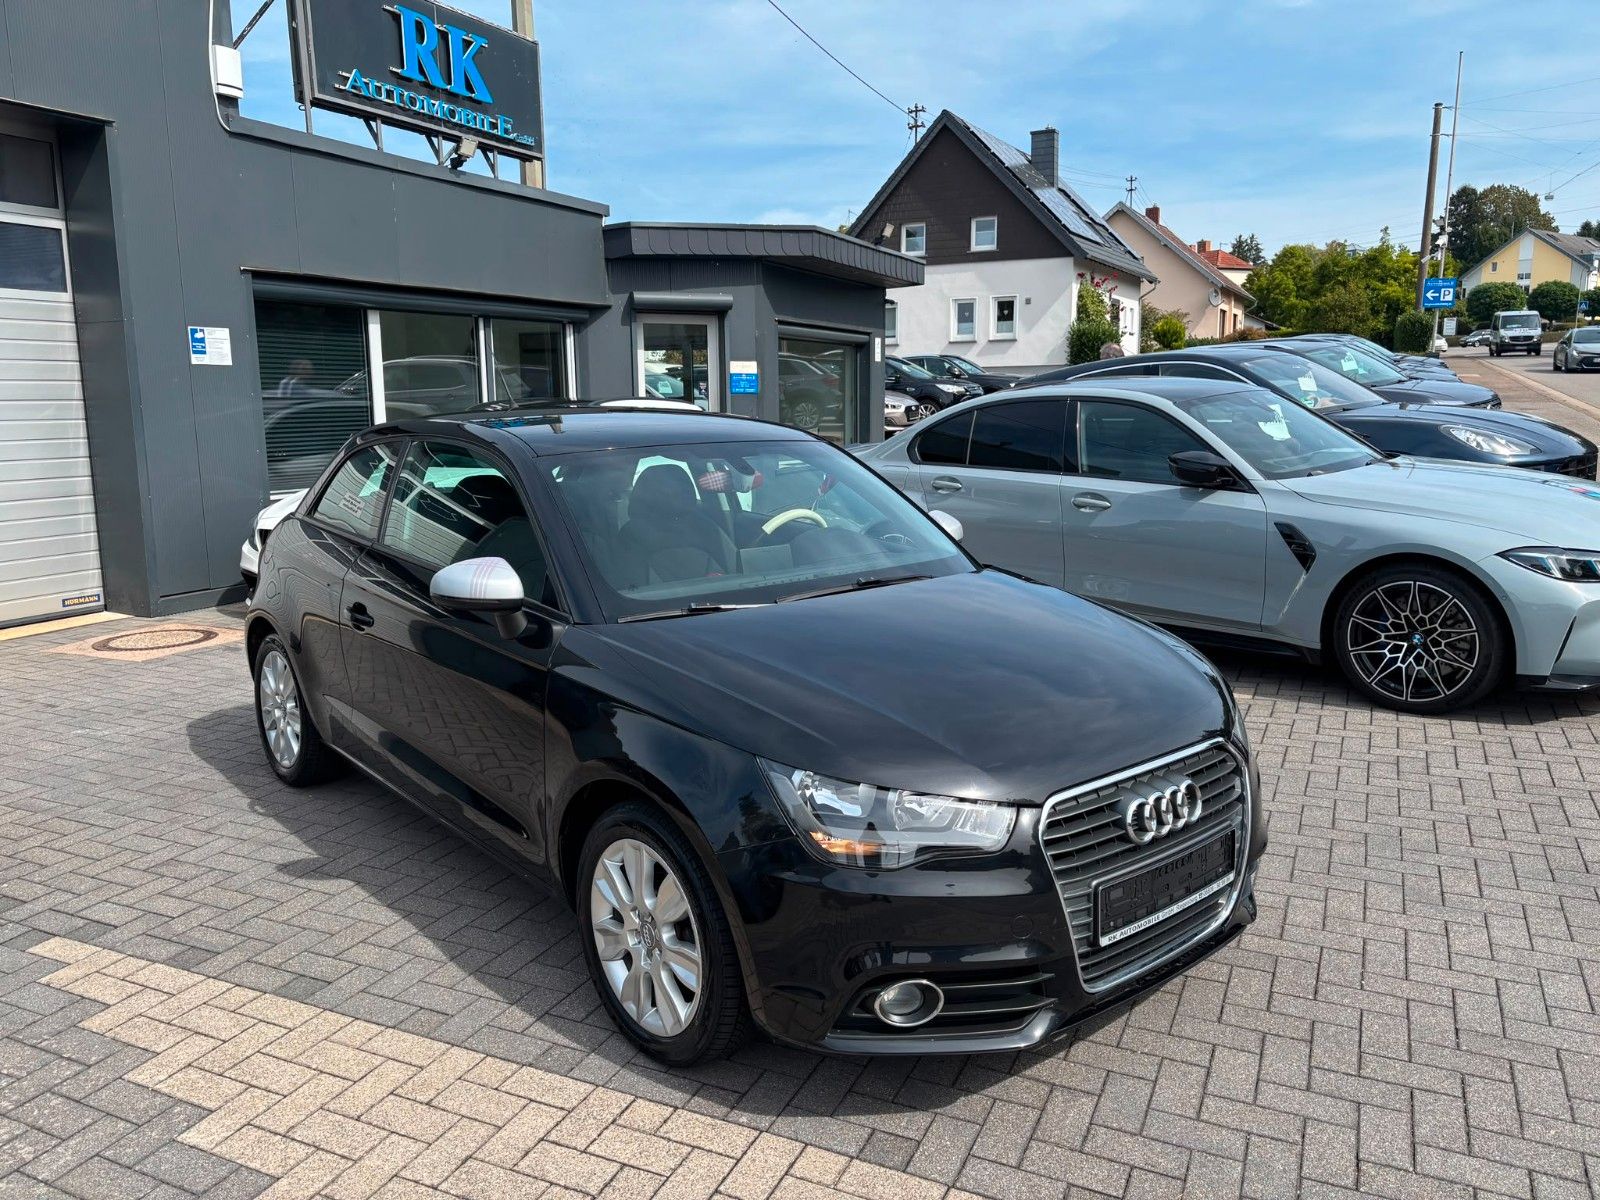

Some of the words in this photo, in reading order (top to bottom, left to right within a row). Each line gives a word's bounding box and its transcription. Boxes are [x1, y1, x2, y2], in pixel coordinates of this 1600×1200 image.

[386, 4, 493, 104] RK
[336, 68, 513, 139] AUTOMOBILE
[1442, 289, 1451, 300] P
[1108, 933, 1118, 943] RK
[1119, 914, 1161, 939] AUTOMOBILE
